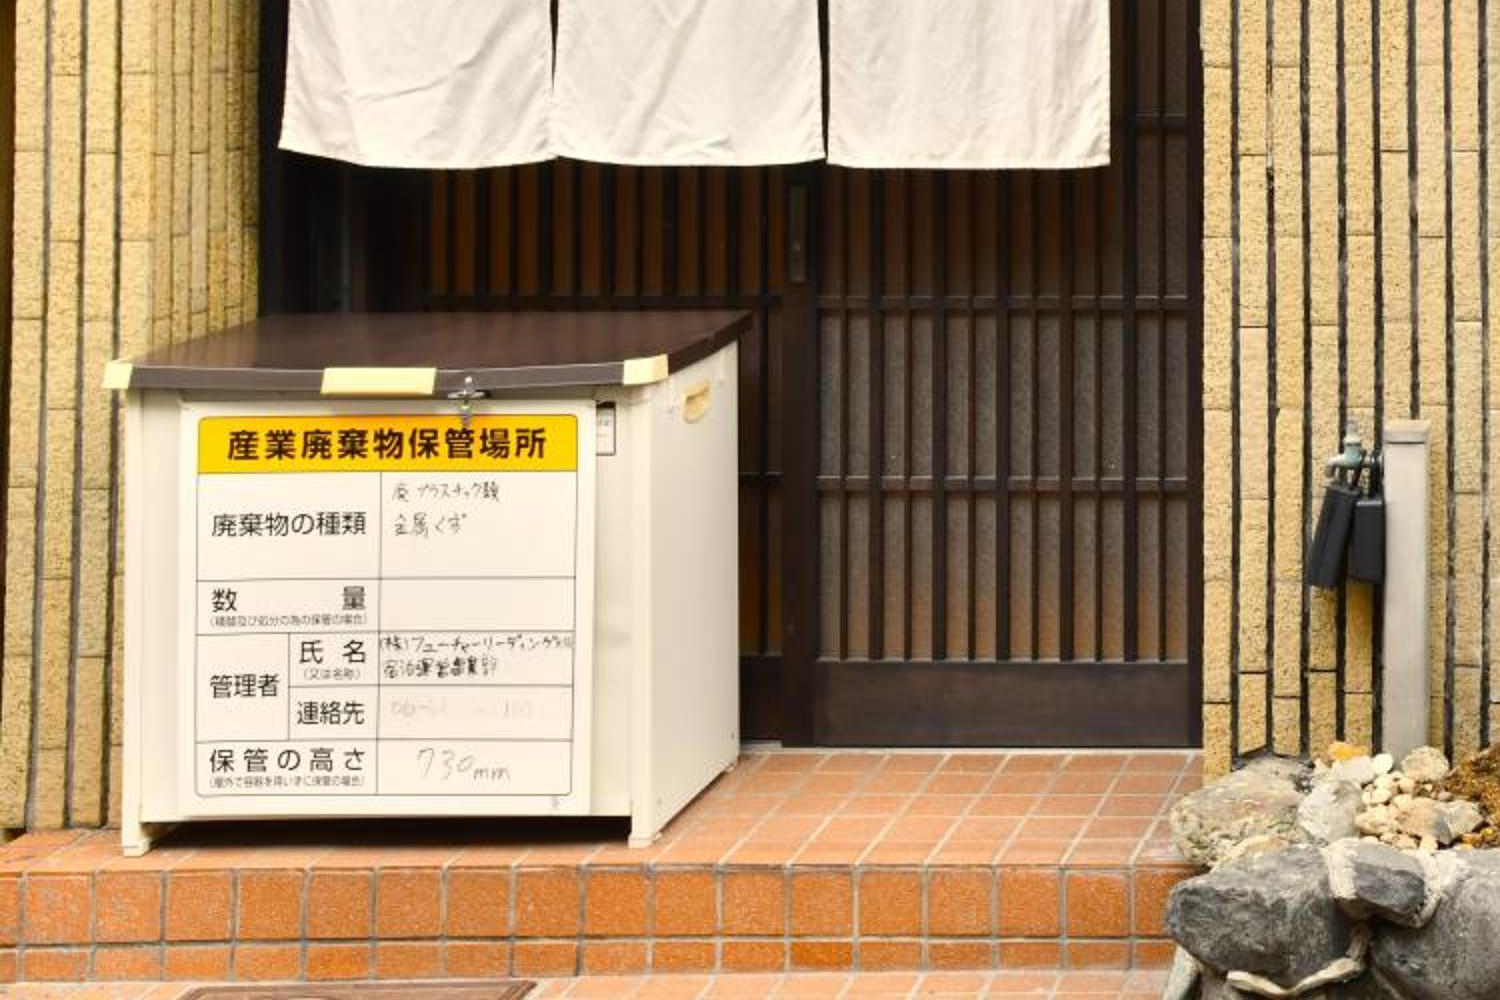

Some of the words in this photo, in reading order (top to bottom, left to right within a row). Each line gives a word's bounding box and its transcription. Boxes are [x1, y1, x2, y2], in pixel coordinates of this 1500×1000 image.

[227, 428, 547, 461] 産業廃棄物保管場所
[211, 511, 367, 537] 廃棄物の種類
[209, 674, 280, 699] 管理者
[296, 700, 365, 725] 連絡先
[209, 747, 366, 773] 保管の高さ
